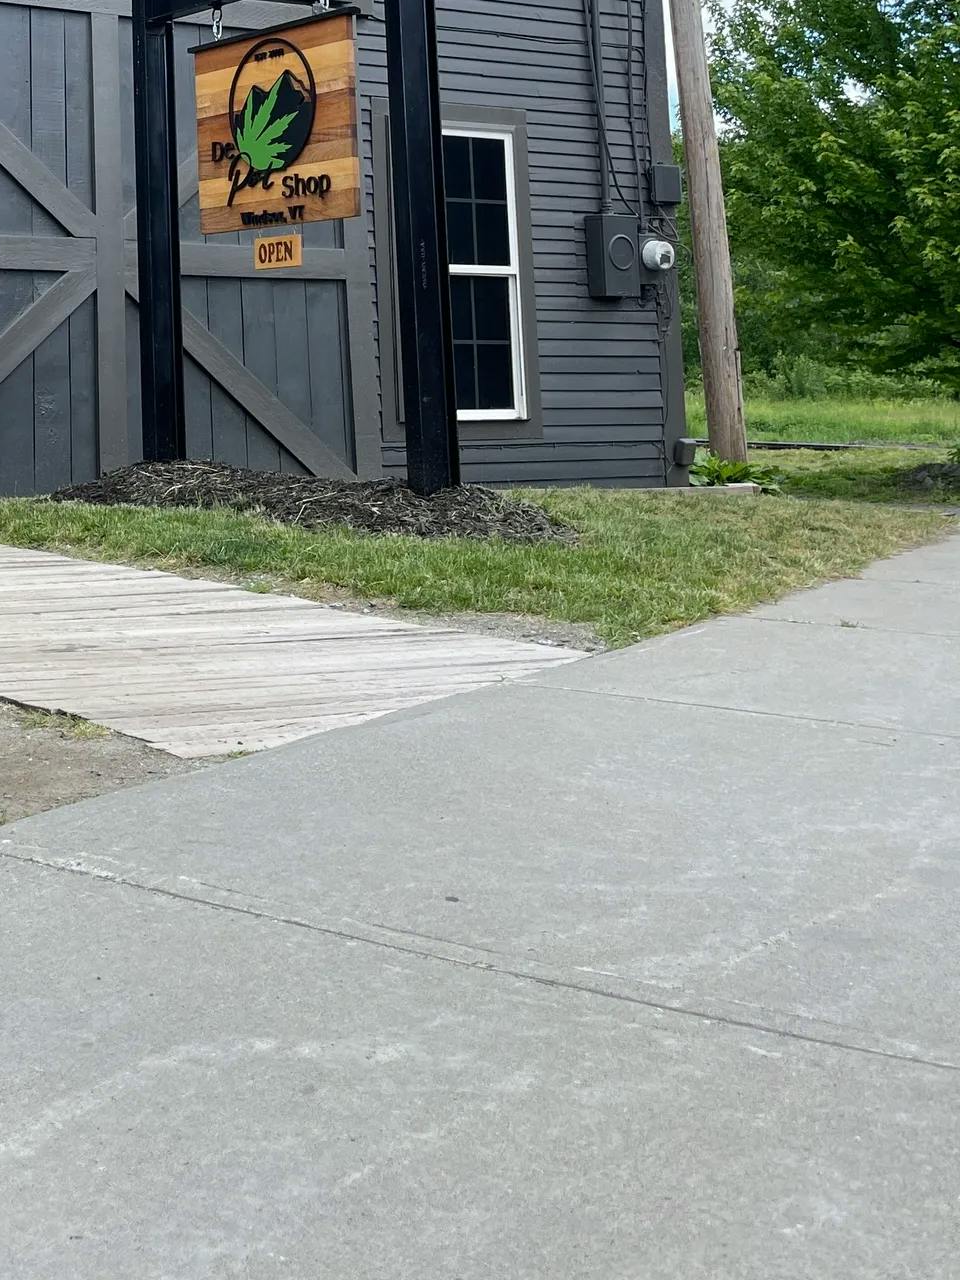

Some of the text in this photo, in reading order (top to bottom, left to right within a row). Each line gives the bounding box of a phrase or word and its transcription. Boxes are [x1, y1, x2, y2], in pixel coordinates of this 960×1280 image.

[211, 141, 235, 162] De
[282, 173, 332, 199] Shop
[288, 205, 305, 221] VT
[258, 240, 294, 264] OPEN
